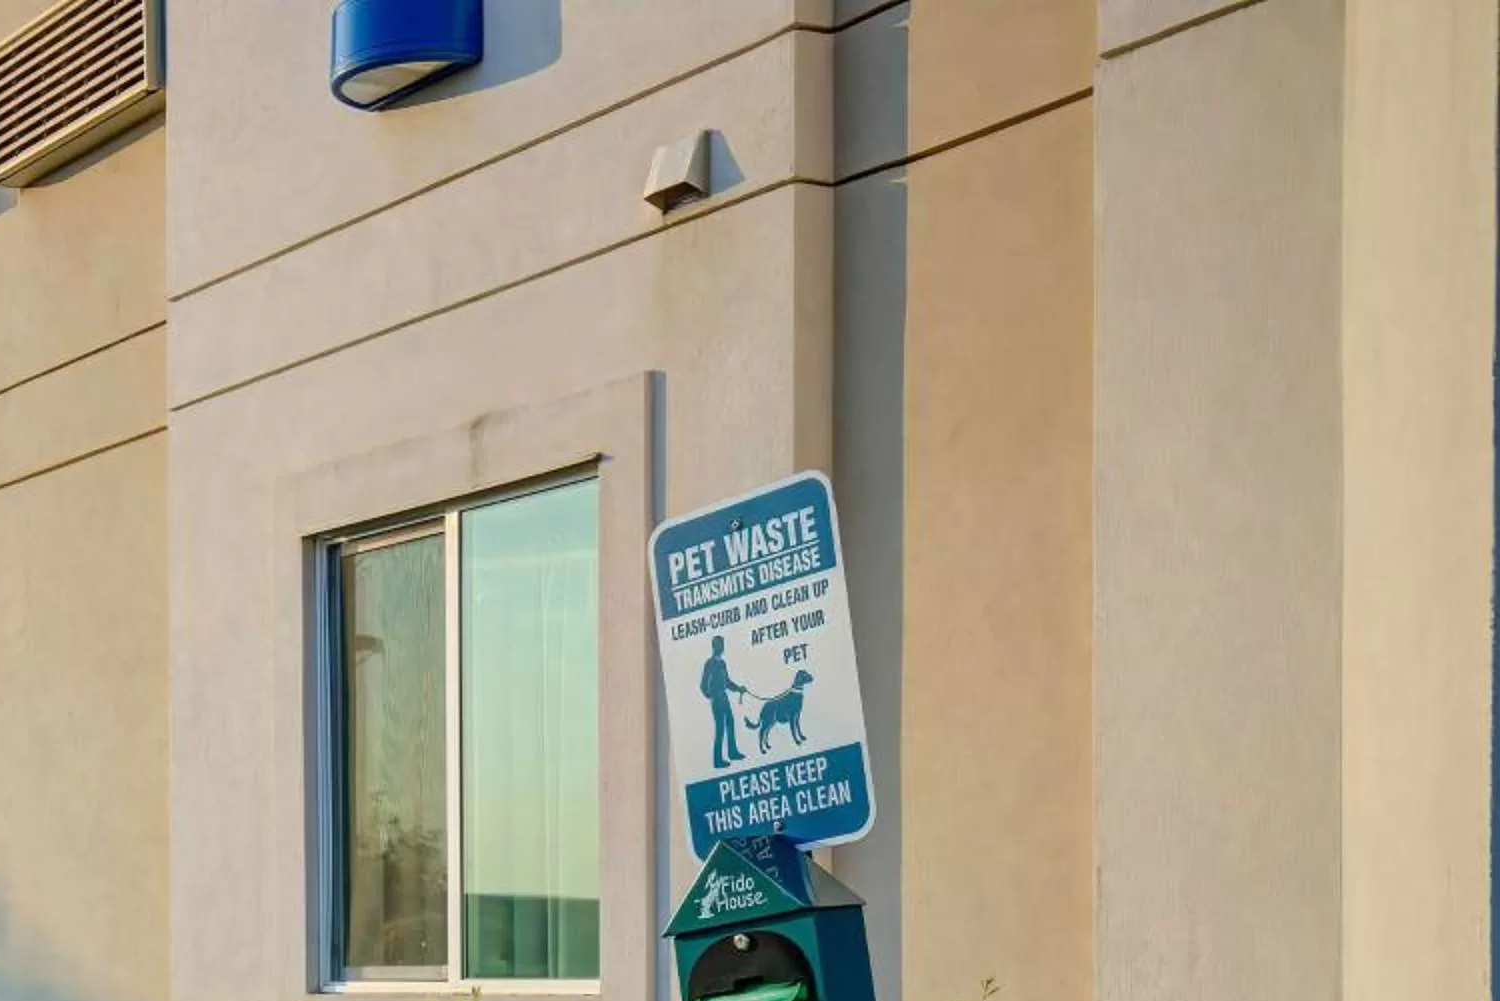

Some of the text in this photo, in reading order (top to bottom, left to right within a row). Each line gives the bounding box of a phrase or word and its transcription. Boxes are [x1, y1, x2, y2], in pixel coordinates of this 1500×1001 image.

[668, 506, 819, 585] PET WASTE
[673, 547, 821, 612] TRANSMITS DISEASE
[671, 579, 829, 641] LEASH-CURB AND CLEAN UP
[751, 609, 825, 646] AFTER YOUR
[783, 643, 809, 665] PET
[719, 757, 828, 803] PLEASE KEEP
[705, 780, 852, 834] THIS AREA CLEAN
[717, 890, 768, 913] House
[721, 872, 755, 894] Fido
